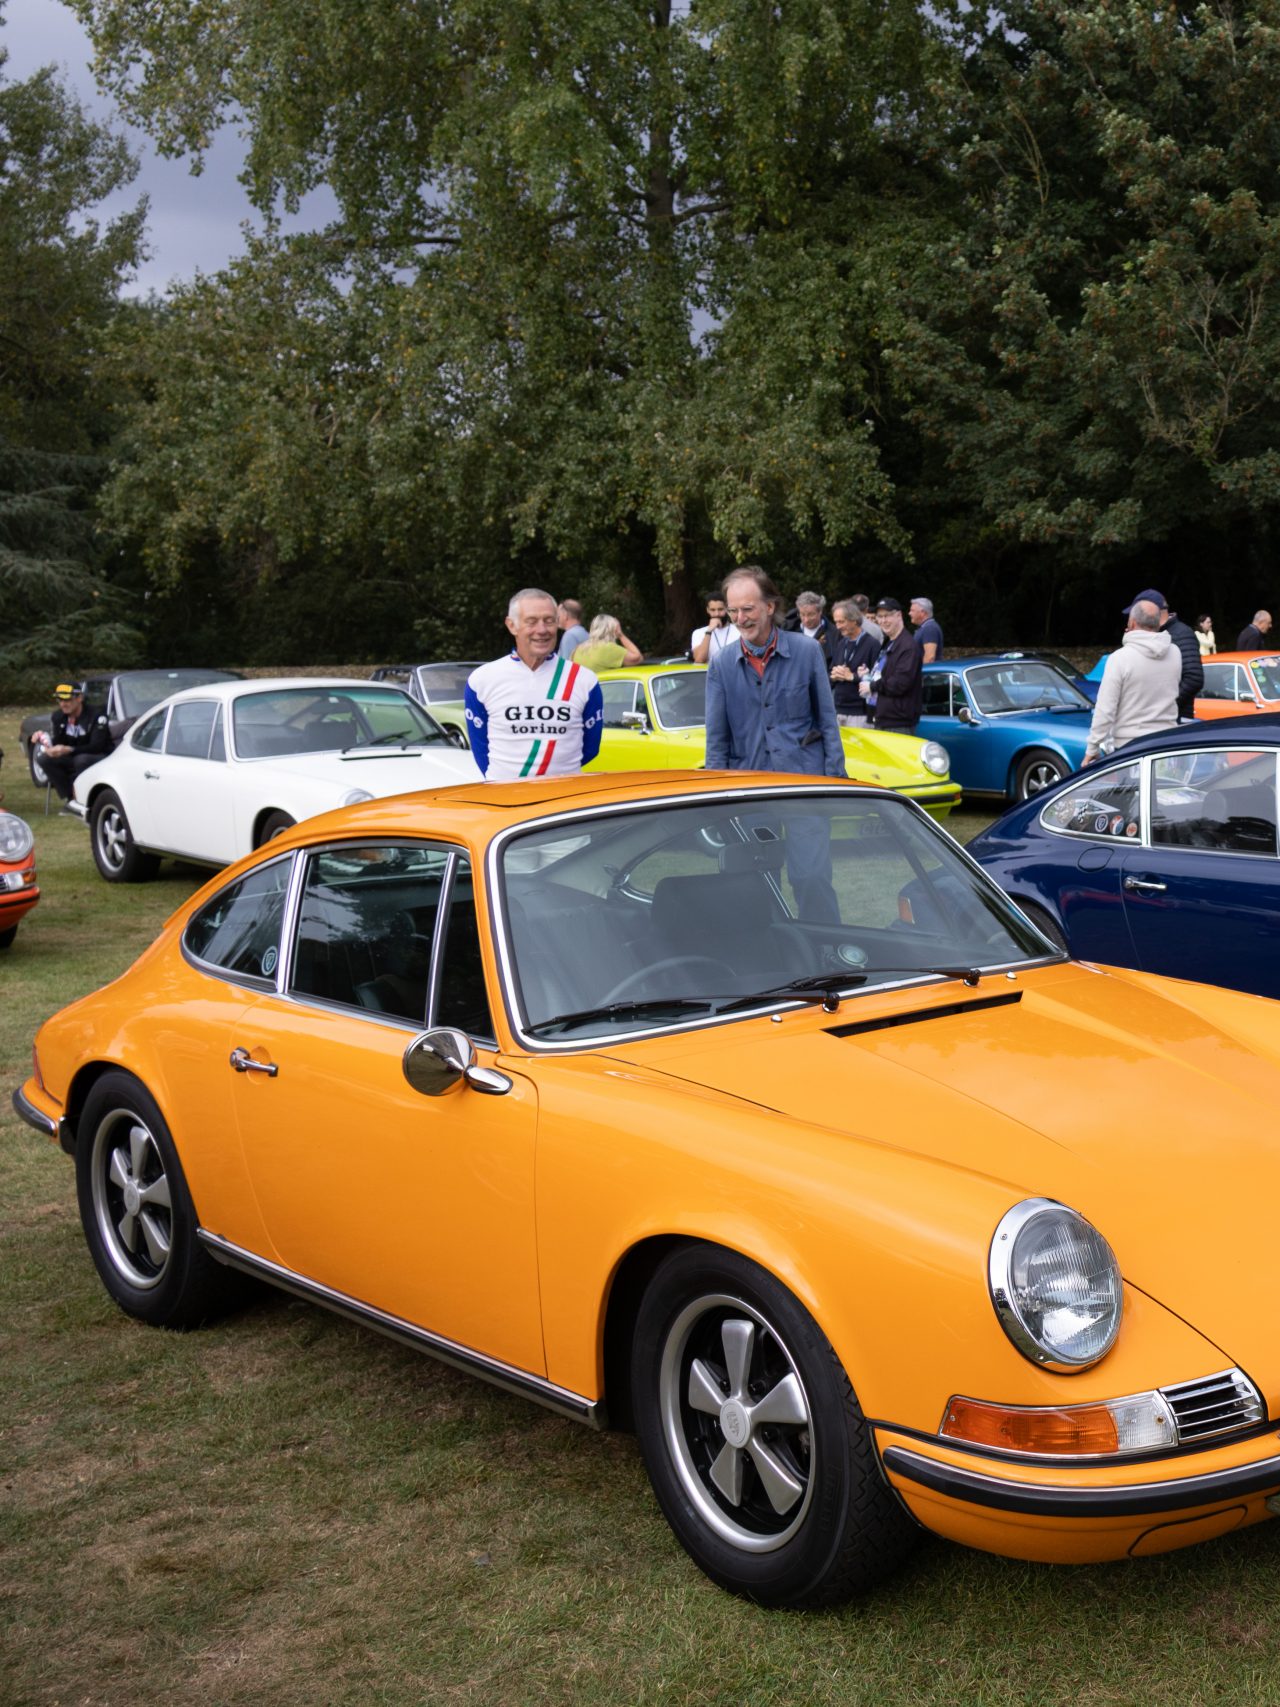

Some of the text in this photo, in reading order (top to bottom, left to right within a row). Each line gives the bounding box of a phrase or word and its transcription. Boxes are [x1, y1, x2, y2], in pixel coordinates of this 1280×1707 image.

[465, 708, 484, 729] OS
[505, 706, 571, 721] GIOS
[585, 709, 604, 729] GI
[511, 723, 567, 735] torino
